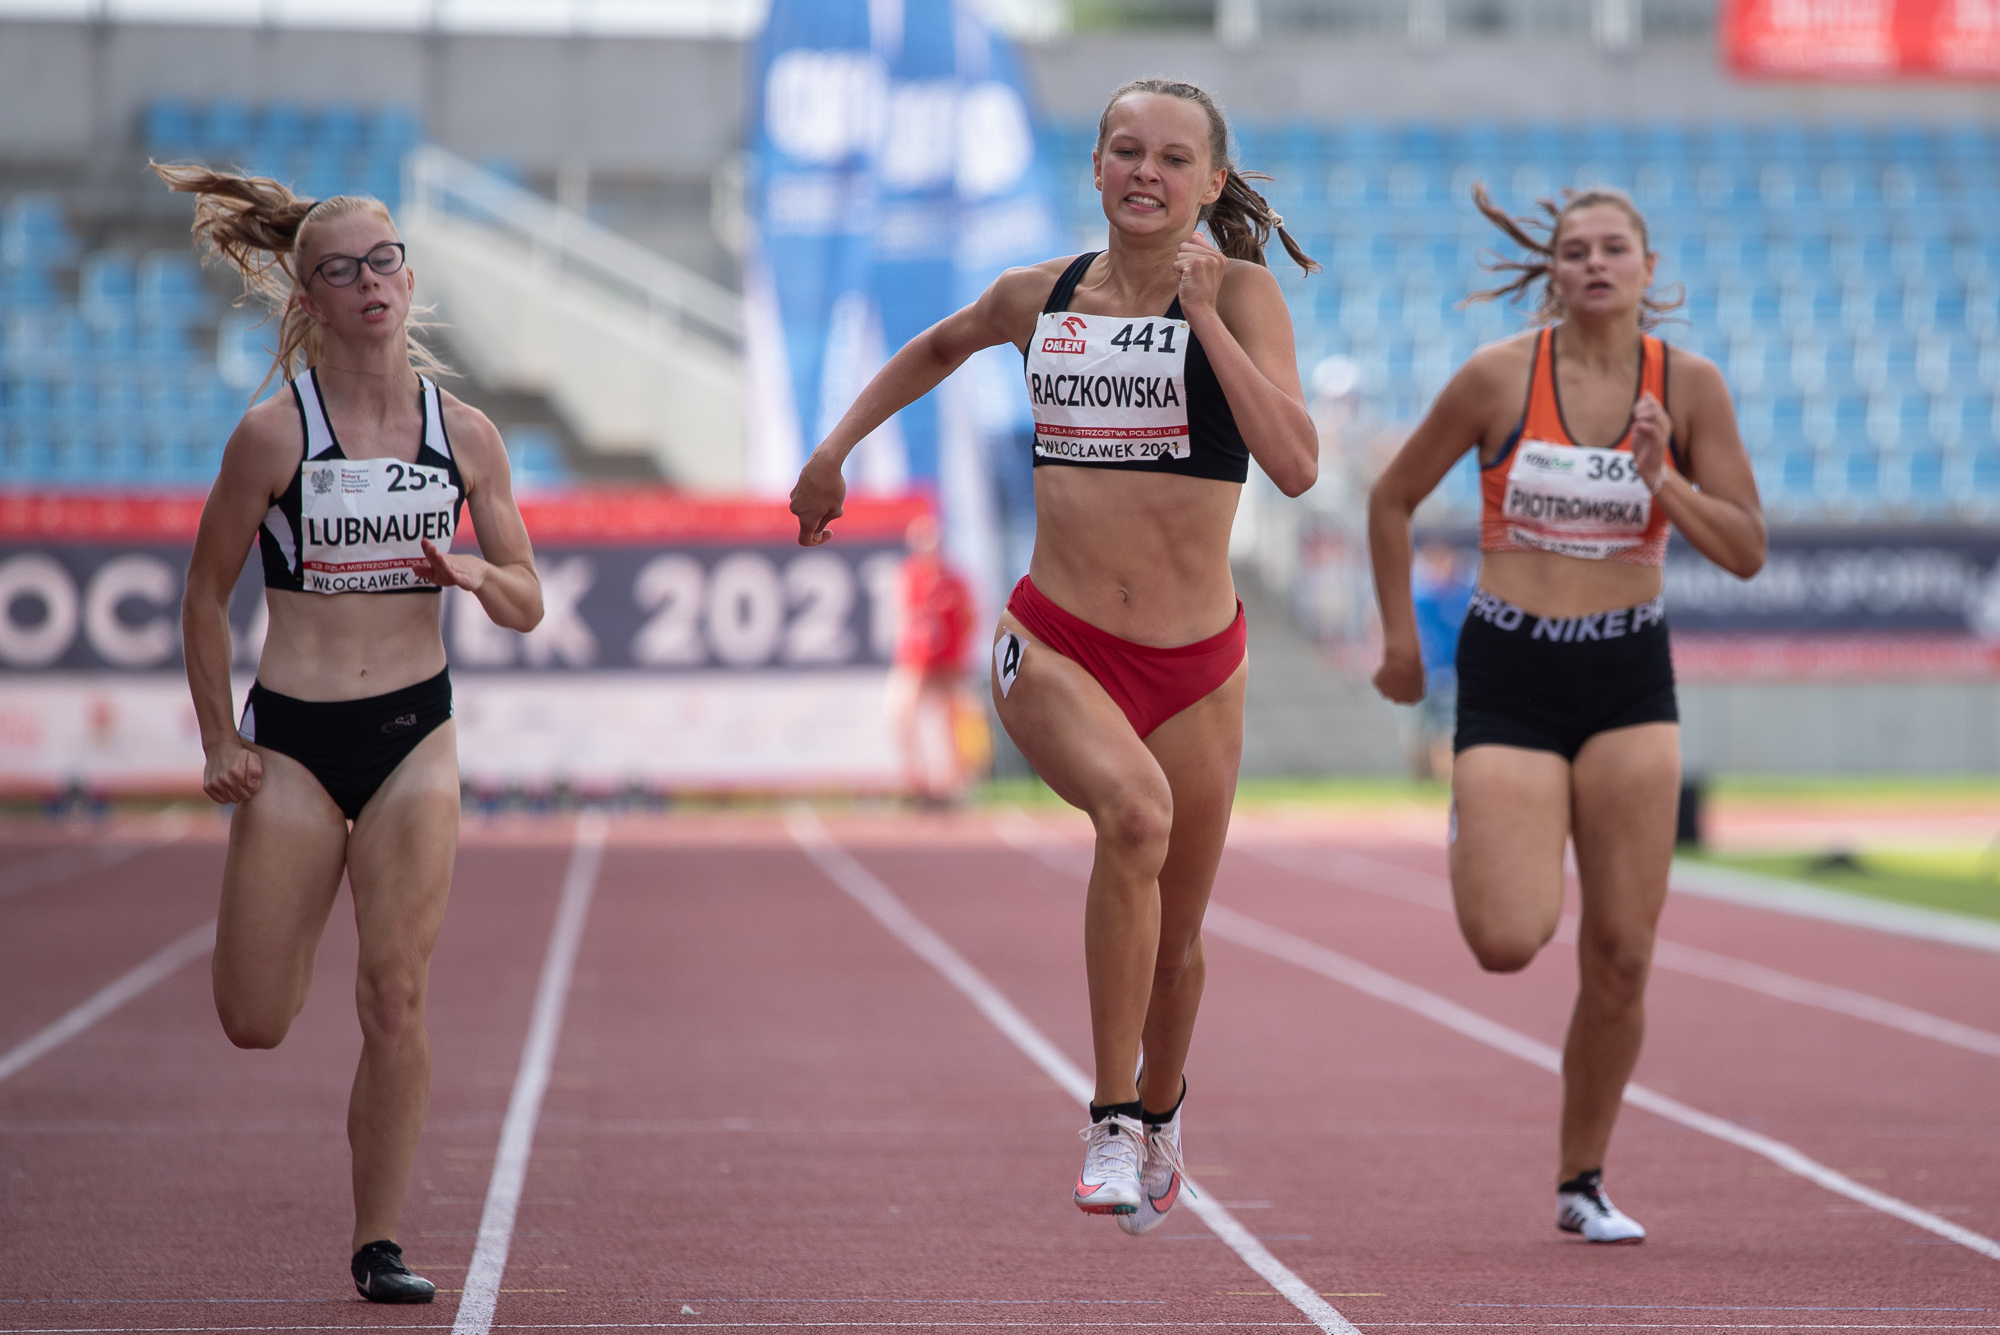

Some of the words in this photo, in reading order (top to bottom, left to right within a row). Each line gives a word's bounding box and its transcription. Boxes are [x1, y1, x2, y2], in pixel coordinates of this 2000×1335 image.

[1044, 339, 1083, 353] ORLEN
[1110, 322, 1176, 354] 441
[1031, 373, 1180, 408] RACZKOWSKA
[1042, 439, 1135, 459] WŁOCŁAWEK
[1068, 429, 1128, 438] MISTRZOSTWA
[1129, 429, 1162, 437] POLSKI
[1509, 487, 1644, 526] PIOTROWSKA
[308, 511, 450, 547] LUBNAUER
[312, 572, 409, 591] WŁOCŁAWEK
[1530, 607, 1629, 643] NIKE
[1631, 594, 1665, 633] PR
[1002, 633, 1020, 680] 4
